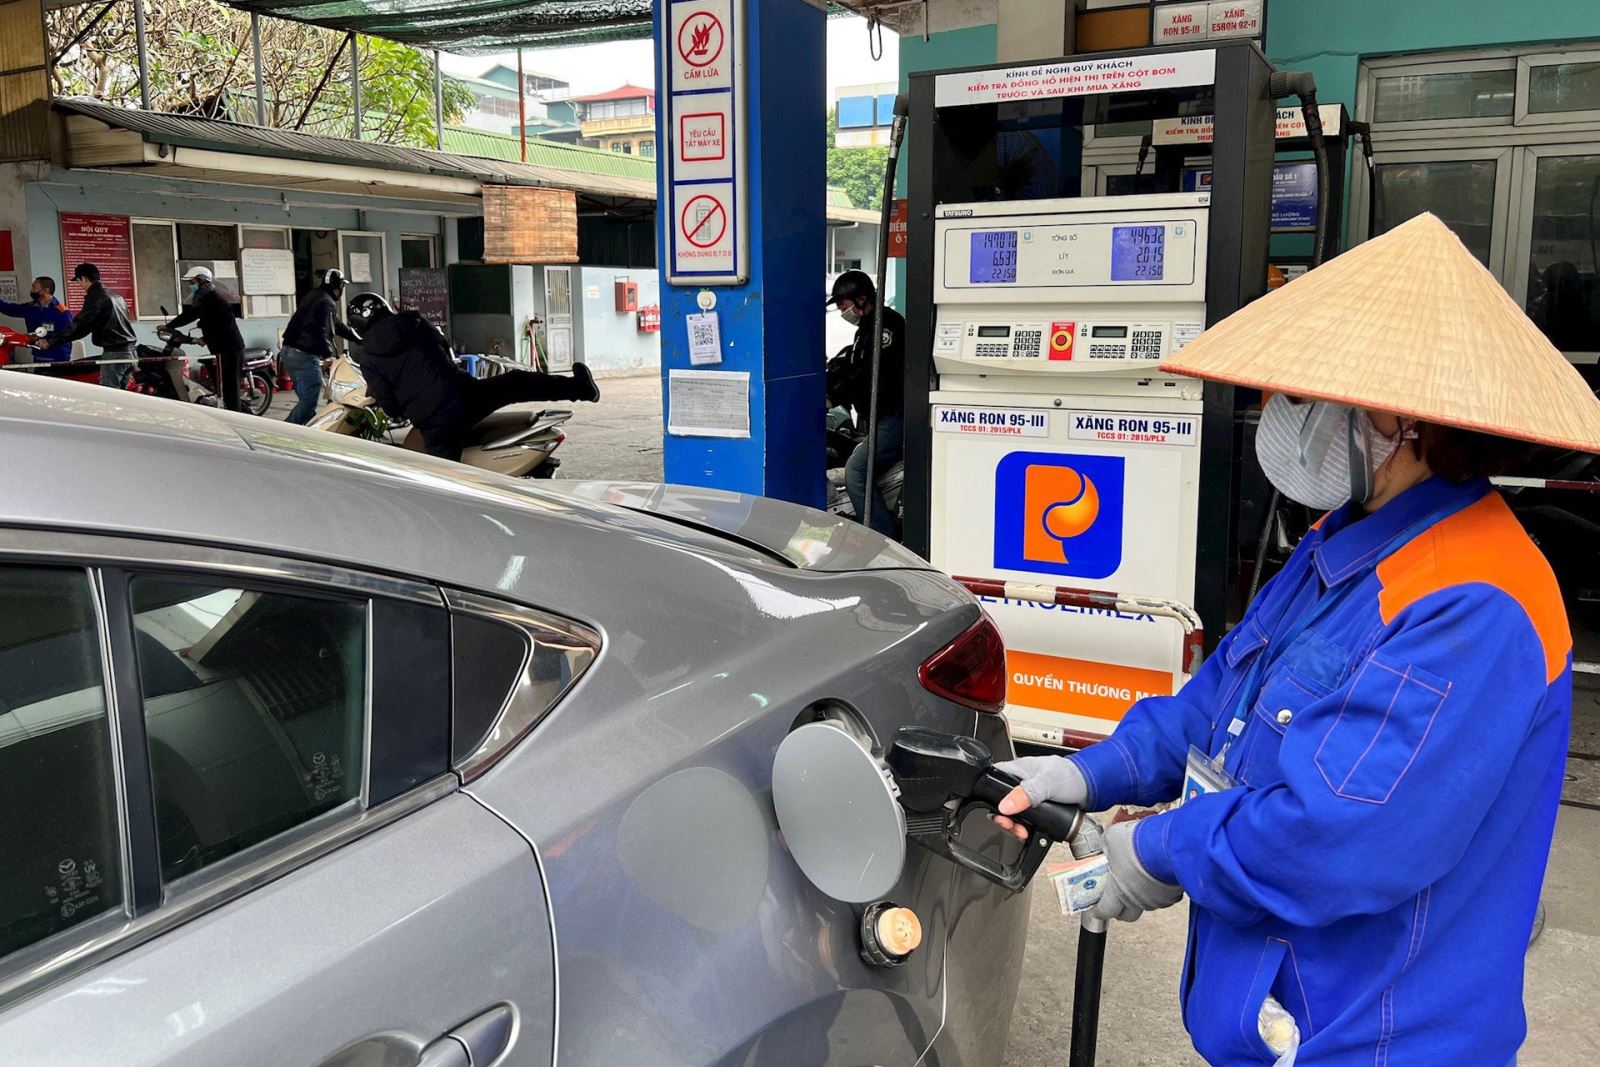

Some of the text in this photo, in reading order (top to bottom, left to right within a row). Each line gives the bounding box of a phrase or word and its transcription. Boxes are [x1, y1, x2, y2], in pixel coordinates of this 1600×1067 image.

[1163, 25, 1200, 36] RON 95-III
[1212, 19, 1256, 32] E5RON 92-II
[1006, 70, 1028, 79] KÍNH
[1045, 66, 1070, 74] NGHỊ
[1073, 63, 1094, 72] QUÝ
[1097, 60, 1133, 70] KHÁCH
[1060, 75, 1080, 84] HIỆN
[1084, 74, 1098, 82] THỊ
[1102, 71, 1125, 80] TRÊN
[1128, 68, 1149, 77] CỘT
[1152, 67, 1176, 76] BƠM
[1031, 88, 1044, 97] VÀ
[1047, 87, 1064, 96] SAU
[1068, 86, 1084, 94] KHI
[1112, 81, 1142, 90] XĂNG
[712, 138, 721, 146] XE
[984, 232, 1017, 249] 147010
[1131, 227, 1164, 244] 44632
[1135, 265, 1163, 276] 22150
[941, 408, 1044, 427] XĂNG RON 95-III
[1075, 414, 1191, 435] XĂNG RON 95-III
[960, 424, 977, 432] TCCS
[990, 426, 1022, 434] 2015/PLX
[1097, 431, 1166, 442] TCCS 01: 2015/PLX
[1013, 671, 1064, 691] QUYỀN
[1067, 680, 1131, 701] THƯƠNG
